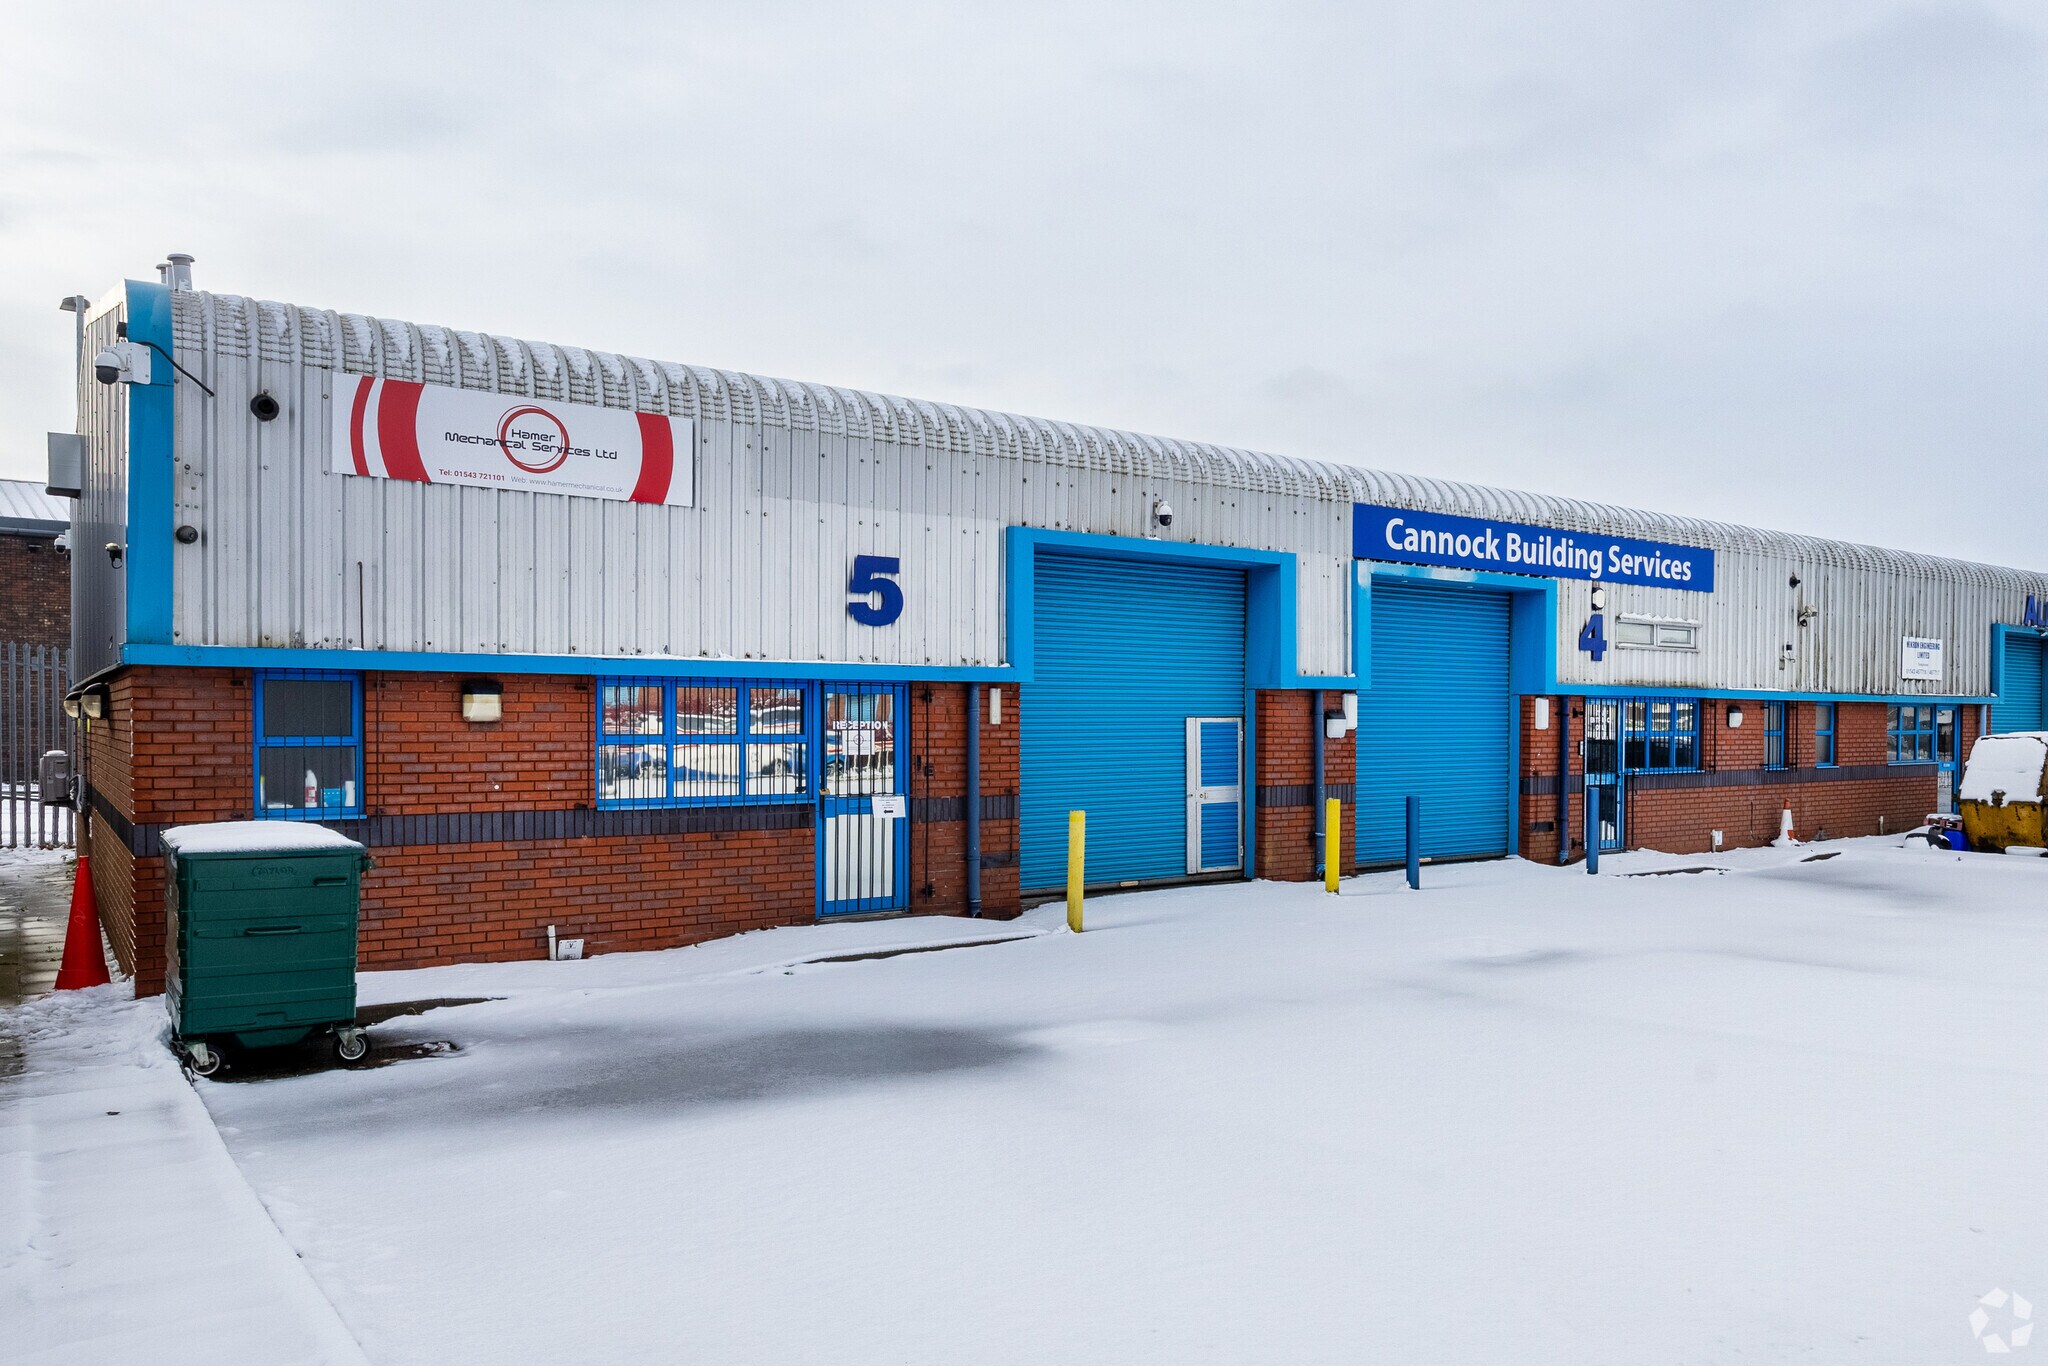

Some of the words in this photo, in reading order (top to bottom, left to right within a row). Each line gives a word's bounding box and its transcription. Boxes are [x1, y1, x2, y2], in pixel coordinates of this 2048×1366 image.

[444, 431, 526, 450] Mechanical
[532, 441, 591, 457] Services
[595, 448, 618, 460] Ltd
[511, 428, 556, 442] Hamer
[438, 468, 453, 477] Tel:
[454, 470, 477, 479] 01543
[479, 472, 505, 481] 721101
[510, 476, 527, 484] Web:
[529, 478, 624, 493] www.hamermechanical.co.uk
[1385, 517, 1500, 560] Cannock
[1506, 532, 1602, 578] Building
[1608, 545, 1692, 581] Services
[848, 554, 904, 627] 5
[1579, 613, 1607, 662] 4
[832, 720, 888, 730] RECEPTION
